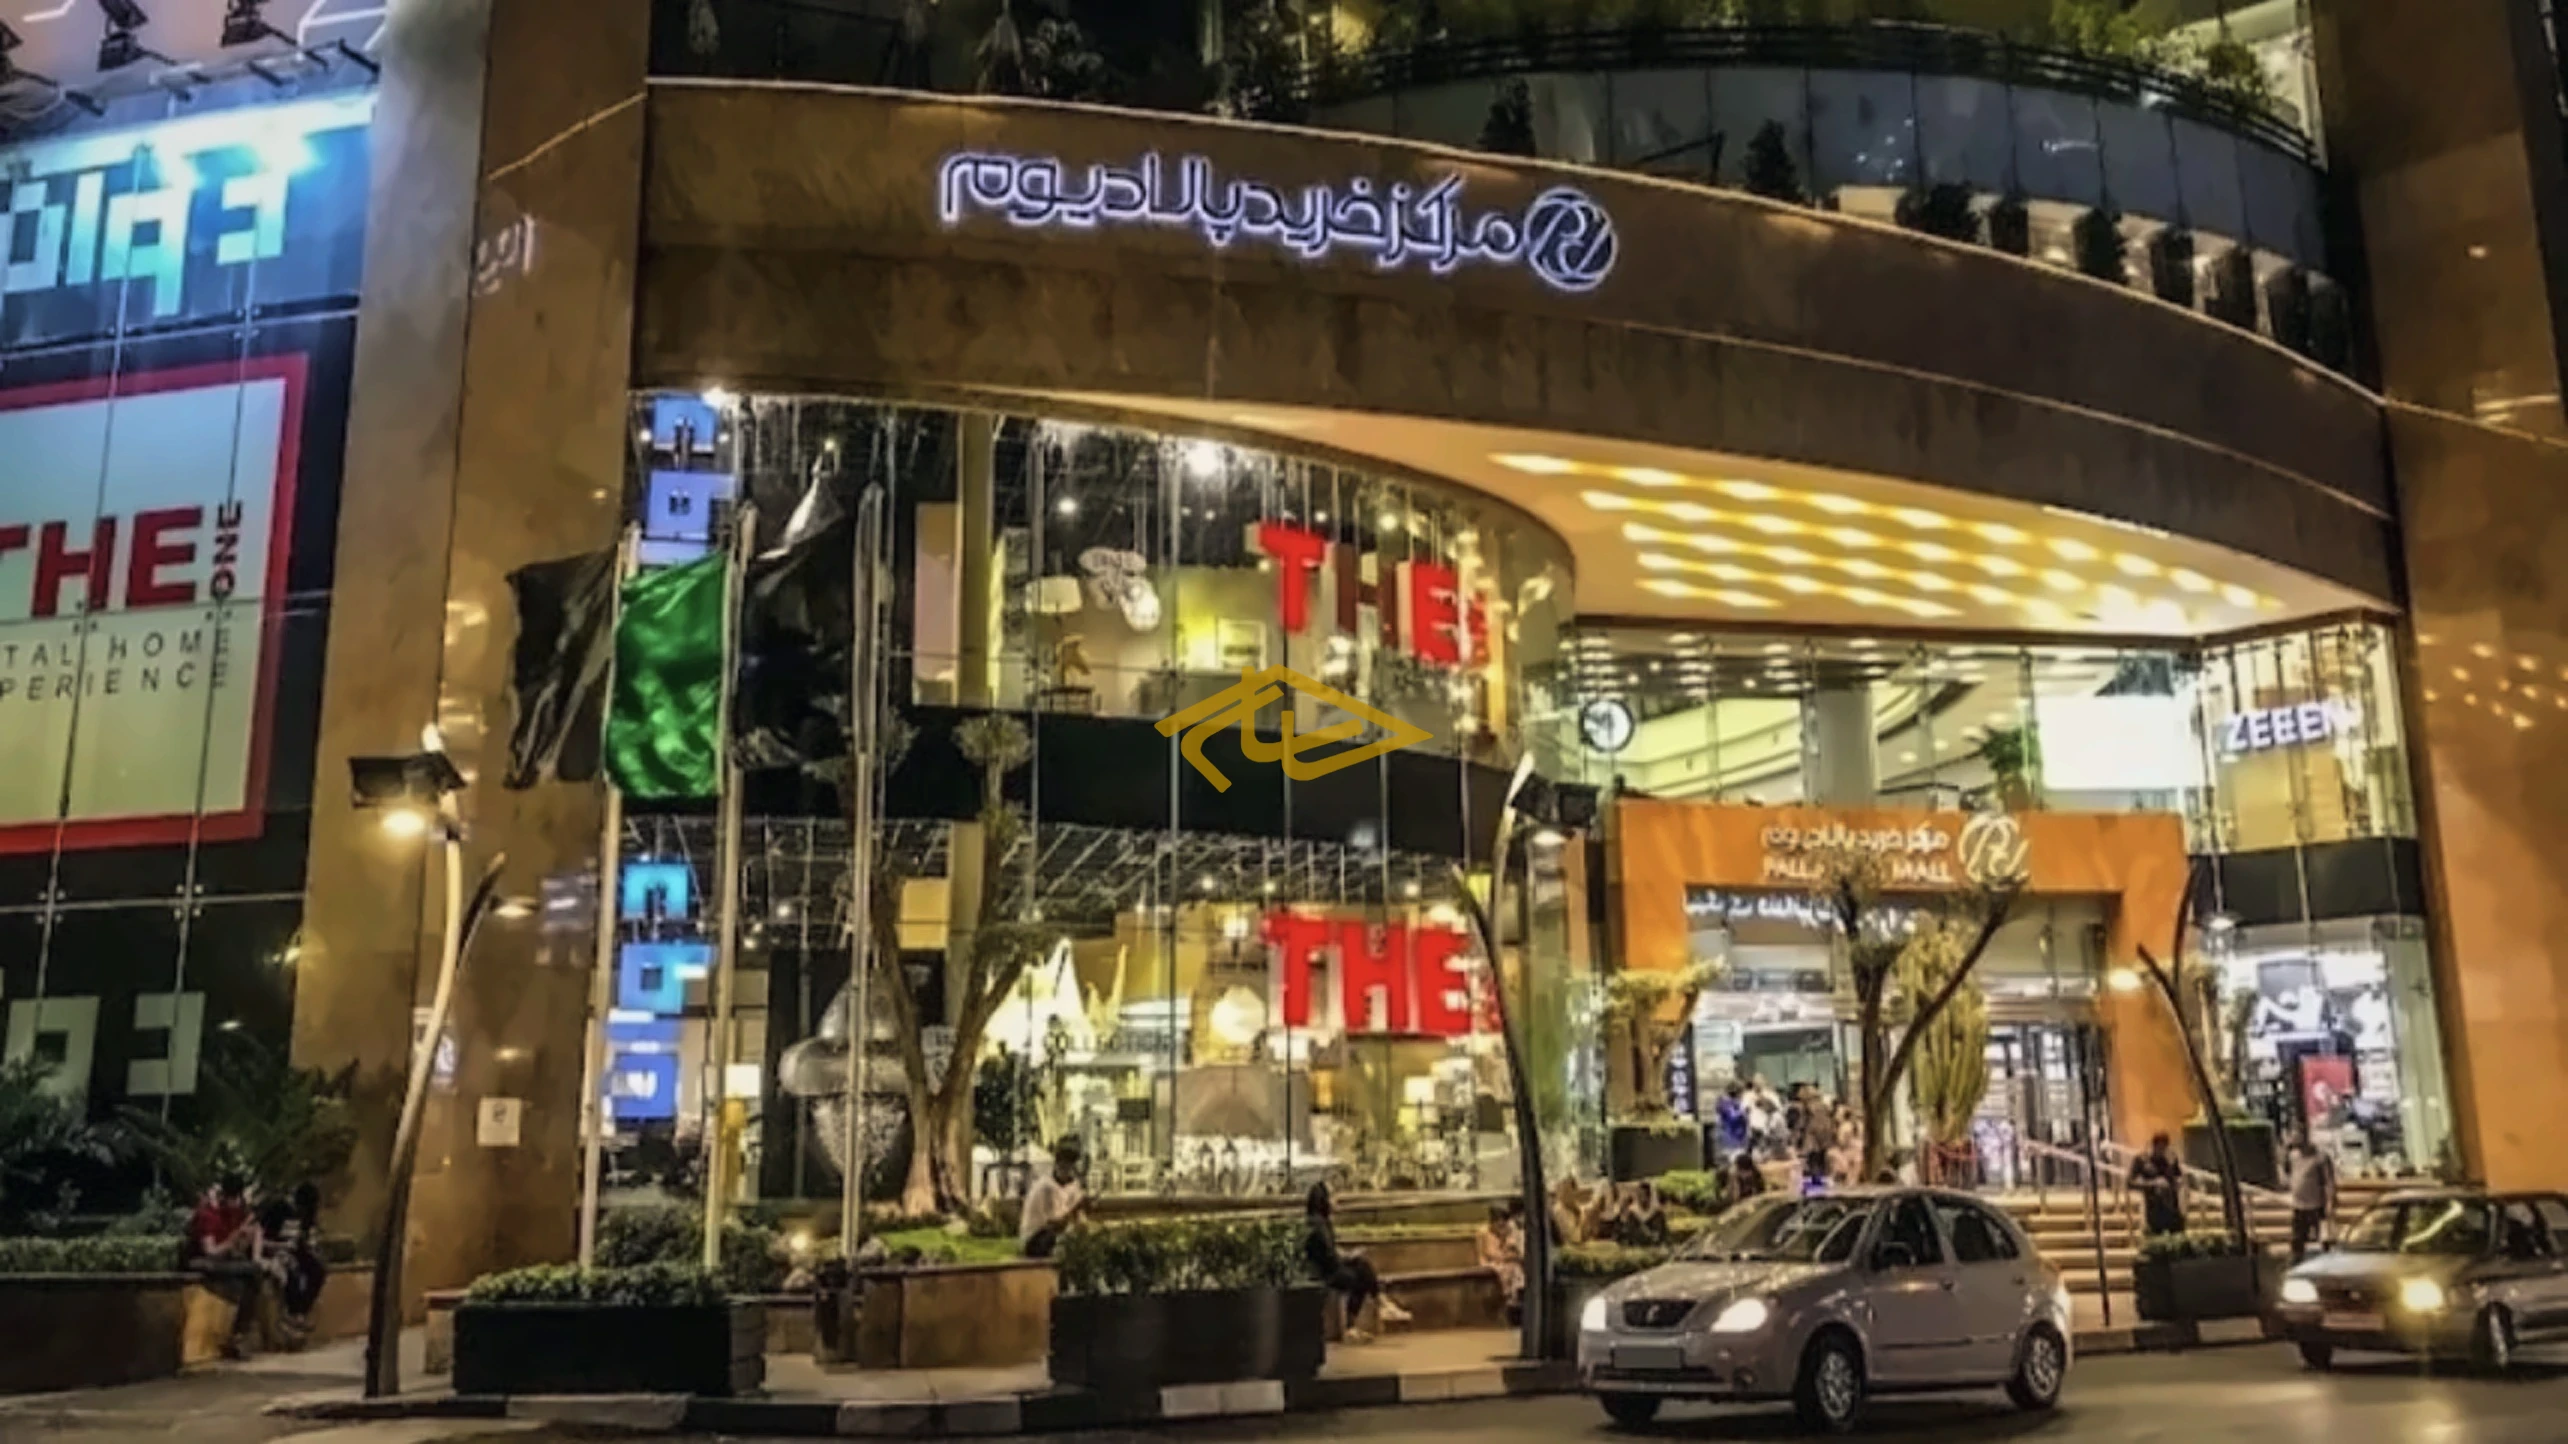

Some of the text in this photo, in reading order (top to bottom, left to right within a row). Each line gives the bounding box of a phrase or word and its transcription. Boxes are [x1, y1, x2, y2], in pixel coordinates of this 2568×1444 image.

[939, 150, 1522, 273] مرکز خرید پالادیوم
[209, 500, 242, 600] ONE
[1258, 517, 1462, 665] THE
[107, 627, 231, 662] HOME
[1263, 908, 1472, 1037] THE
